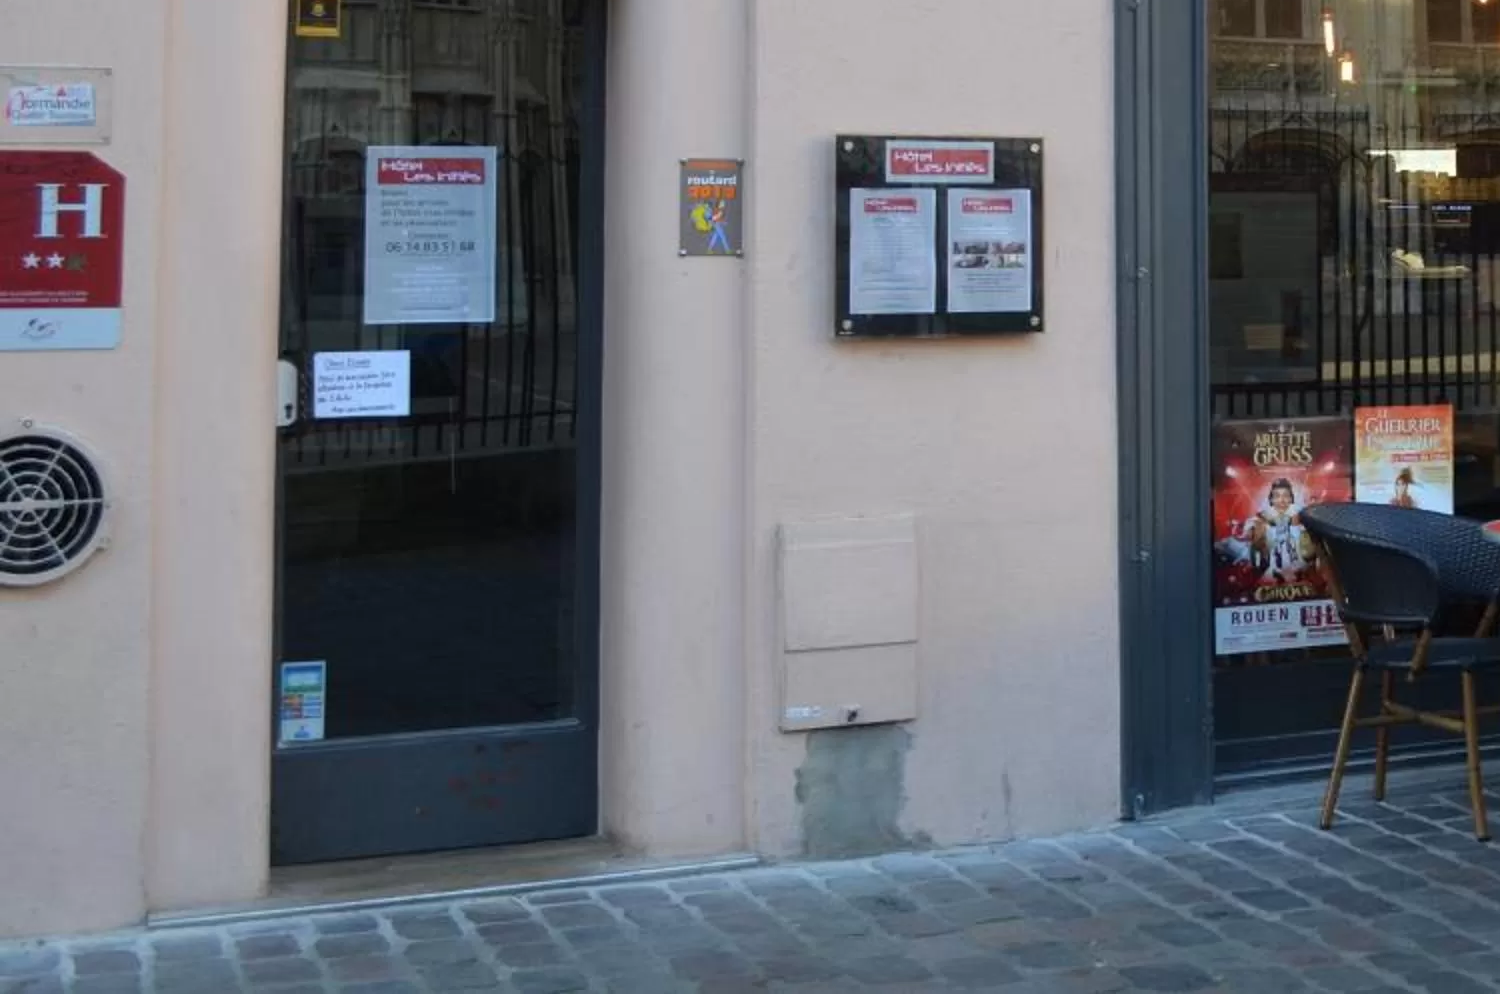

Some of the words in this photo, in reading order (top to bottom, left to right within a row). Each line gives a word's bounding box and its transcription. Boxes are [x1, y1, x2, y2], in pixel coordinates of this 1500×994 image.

[33, 183, 110, 239] H
[1364, 416, 1442, 435] GUERRIER
[1254, 430, 1312, 448] ARLETTE
[1252, 445, 1313, 468] GRUSS
[1231, 607, 1290, 625] ROUEN
